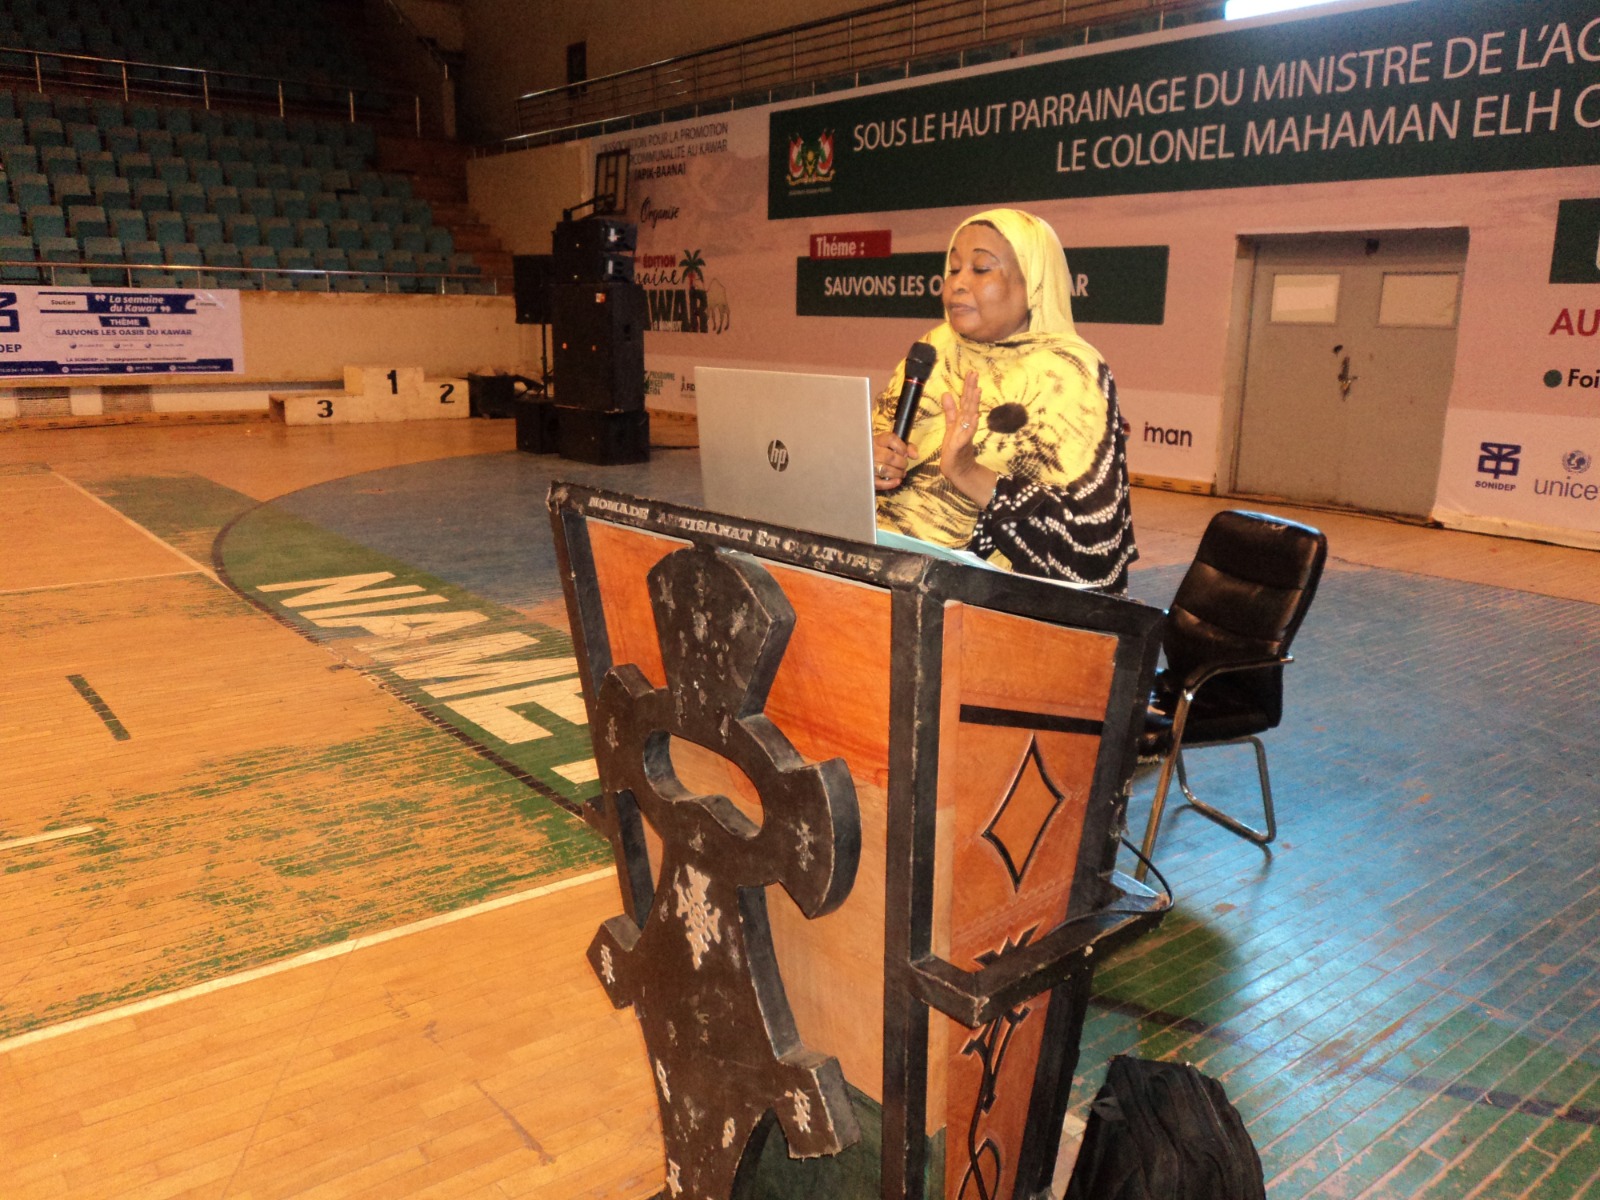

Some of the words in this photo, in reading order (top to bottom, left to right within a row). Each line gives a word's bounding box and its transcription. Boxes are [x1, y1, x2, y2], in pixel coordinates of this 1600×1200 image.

[854, 117, 907, 152] SOUS
[911, 114, 936, 145] LE
[941, 103, 1007, 141] HAUT
[1010, 76, 1188, 132] PARRAINAGE
[1194, 68, 1246, 110] DU
[1253, 41, 1433, 103] MINISTRE
[1442, 31, 1506, 80] DE
[648, 133, 668, 146] POUR
[670, 132, 679, 144] LA
[680, 121, 728, 141] PROMOTION
[1057, 139, 1087, 174] LE
[1092, 125, 1234, 171] COLONEL
[1243, 100, 1460, 157] MAHAMAN
[1472, 88, 1561, 138] ELH
[699, 138, 728, 155] KAWAR
[640, 196, 680, 229] Organise
[642, 254, 676, 269] ÉDITION
[824, 275, 896, 297] SAUVONS
[900, 275, 925, 296] LES
[929, 275, 944, 296] O
[109, 295, 121, 304] La
[123, 295, 164, 304] semaine
[109, 304, 123, 312] du
[124, 304, 157, 312] Kawar
[386, 369, 399, 395] 1
[440, 383, 455, 404] 2
[316, 400, 334, 418] 3
[1144, 421, 1193, 448] iman
[769, 440, 788, 472] hp
[1475, 480, 1517, 492] SONIDEP
[1534, 475, 1600, 501] unice
[588, 496, 649, 521] NOMADE
[256, 571, 600, 784] NIAME
